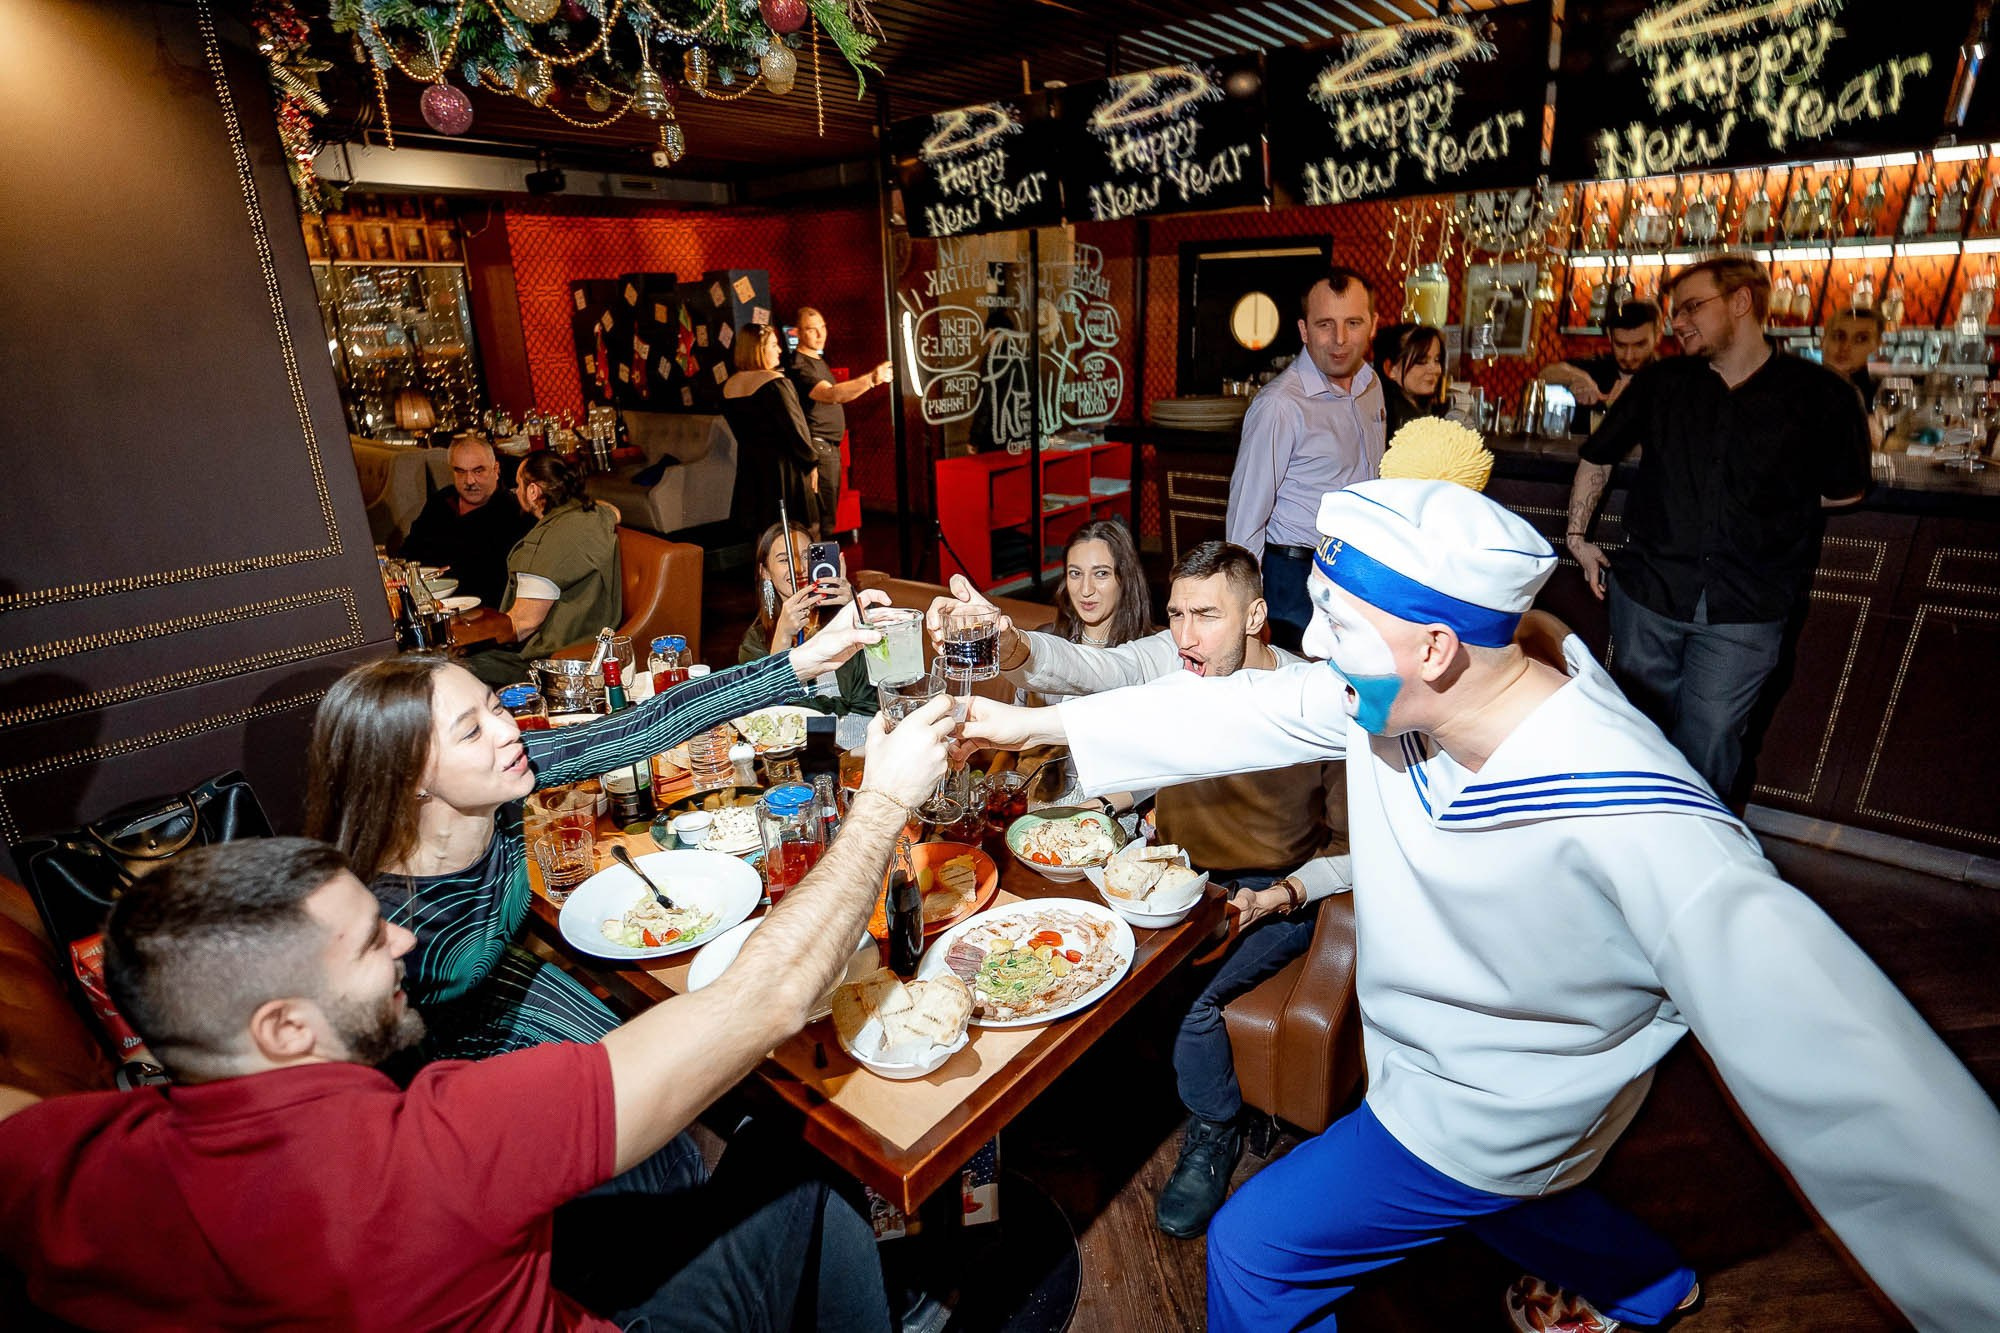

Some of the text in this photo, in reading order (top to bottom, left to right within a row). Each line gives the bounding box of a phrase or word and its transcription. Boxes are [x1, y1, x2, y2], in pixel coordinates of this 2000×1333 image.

[1650, 18, 1845, 114] Happy
[1107, 118, 1202, 173] Happy
[1334, 81, 1463, 151] Happy
[1597, 52, 1933, 180] New Year
[937, 149, 1007, 196] Happy
[1089, 144, 1250, 220] New Year
[1303, 110, 1526, 205] New Year
[925, 170, 1047, 236] New Year
